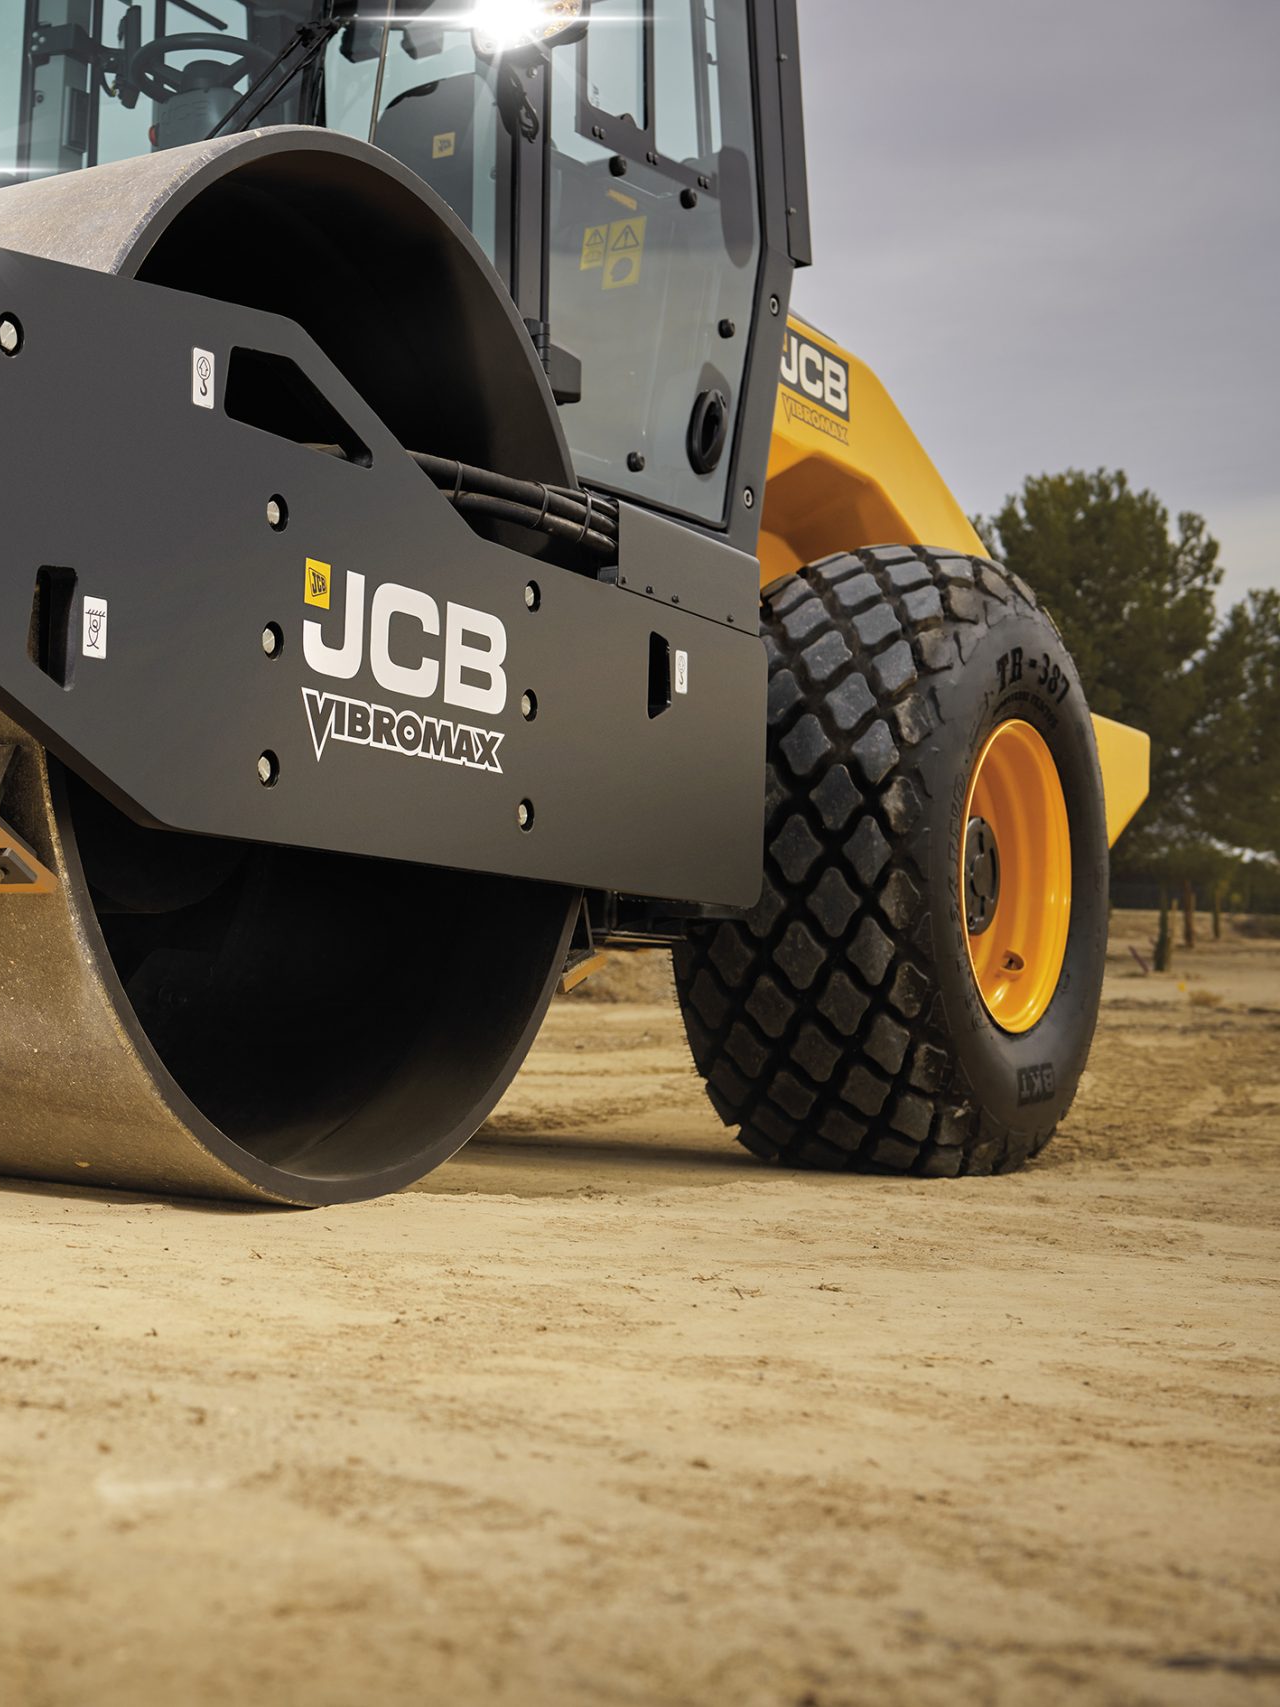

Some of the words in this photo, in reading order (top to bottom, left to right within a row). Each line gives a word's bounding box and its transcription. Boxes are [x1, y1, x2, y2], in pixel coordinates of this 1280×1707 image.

[780, 335, 848, 413] JCB
[781, 392, 849, 446] VIBROMAX
[303, 570, 508, 715] JCB
[301, 686, 506, 774] VIBROMAX
[1018, 1064, 1055, 1103] BKT
